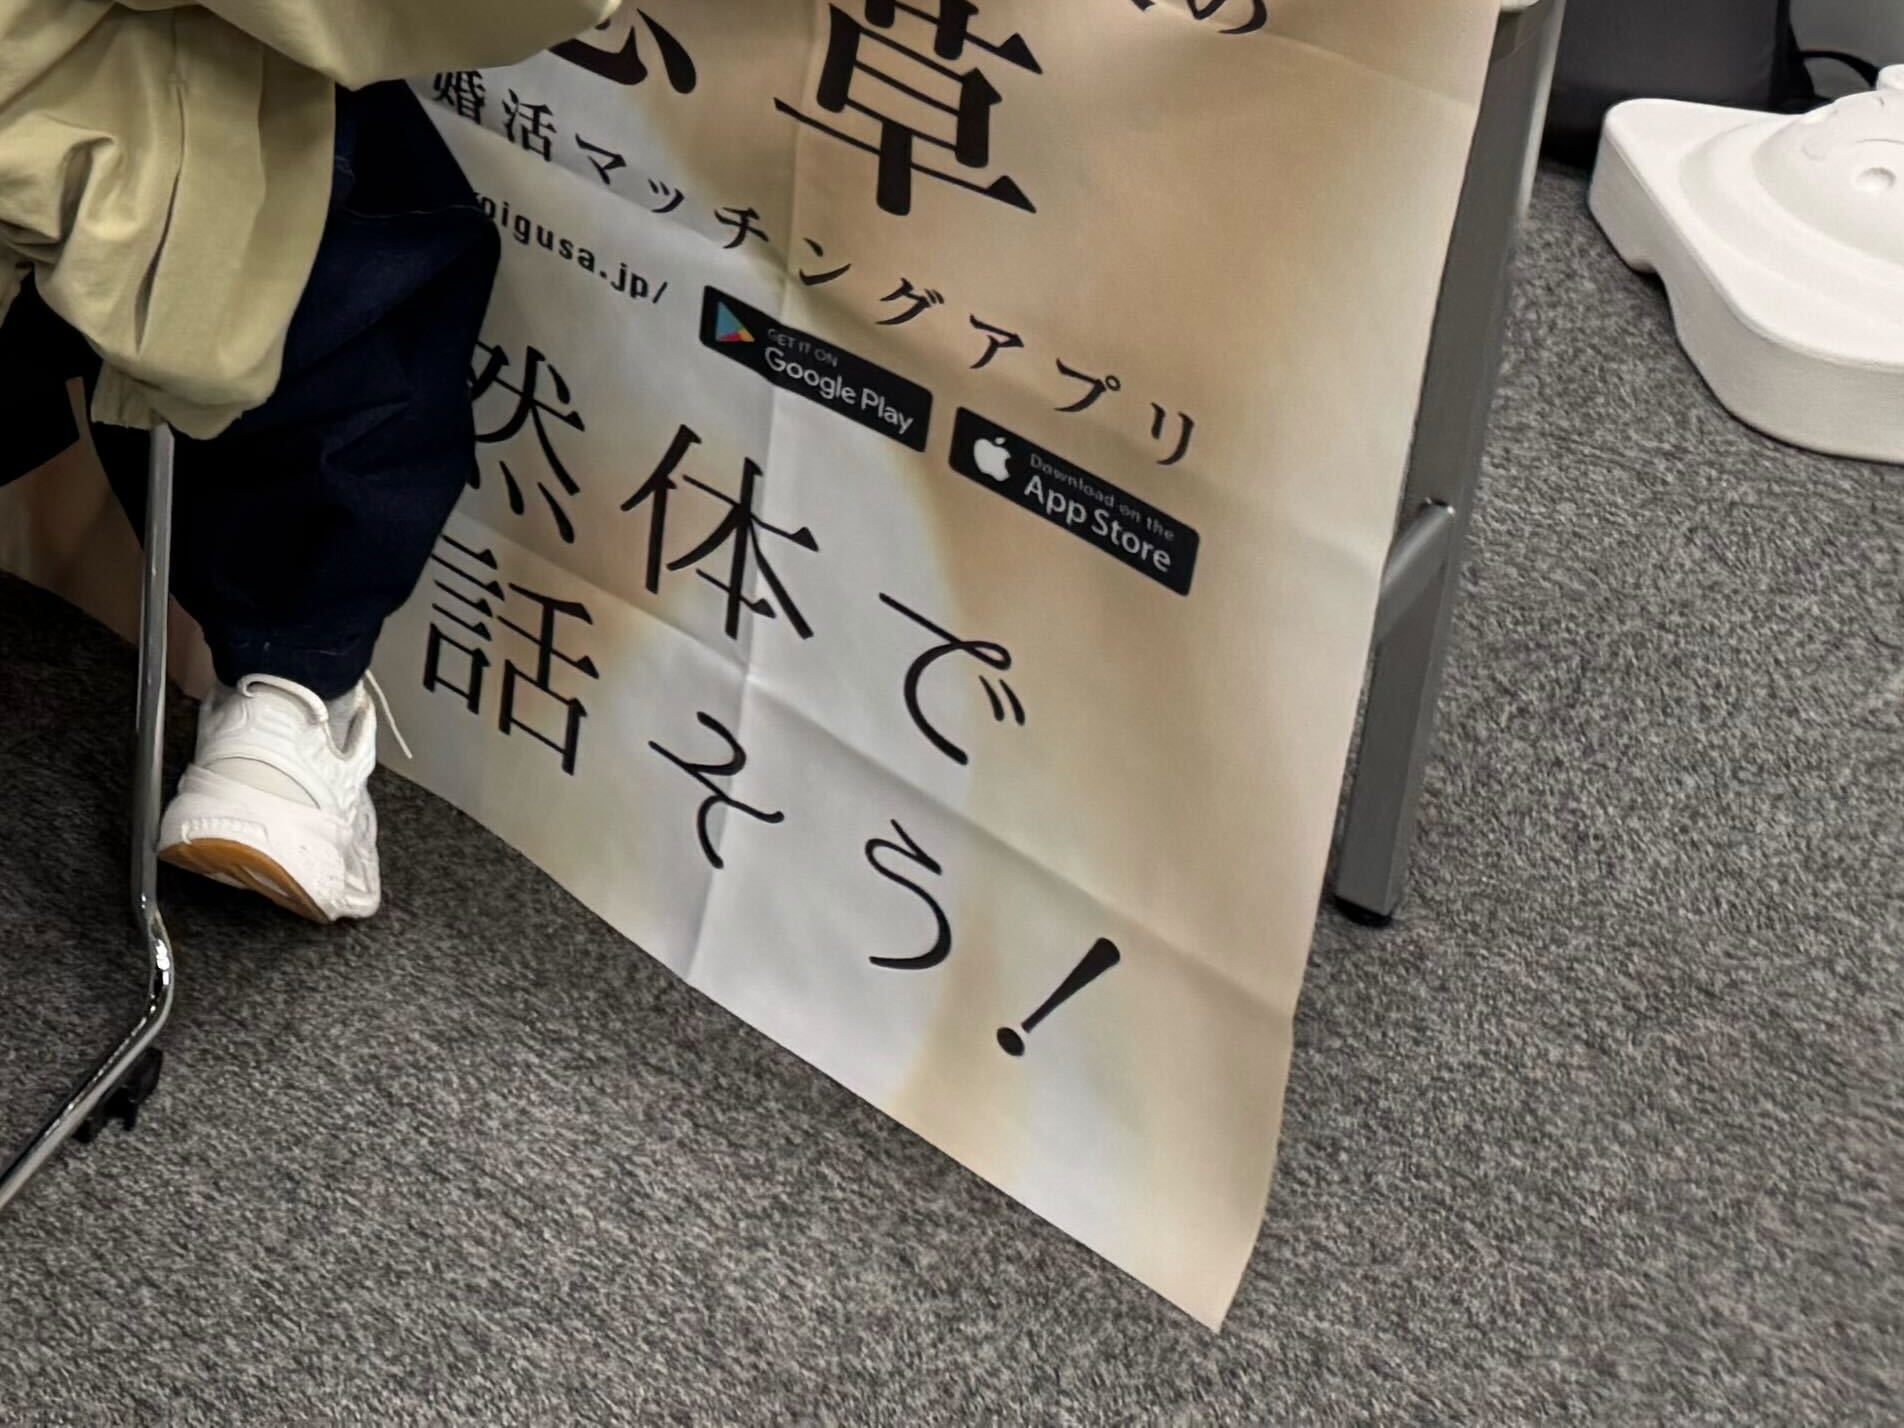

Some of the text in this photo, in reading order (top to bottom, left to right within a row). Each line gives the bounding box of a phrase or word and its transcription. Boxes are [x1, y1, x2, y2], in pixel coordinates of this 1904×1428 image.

[432, 68, 1198, 468] 婚活マッチングアプリ
[763, 345, 915, 435] Google Play
[1023, 474, 1172, 575] App Store
[1029, 452, 1175, 543] Download on the
[422, 532, 1122, 1058] 話そう！
